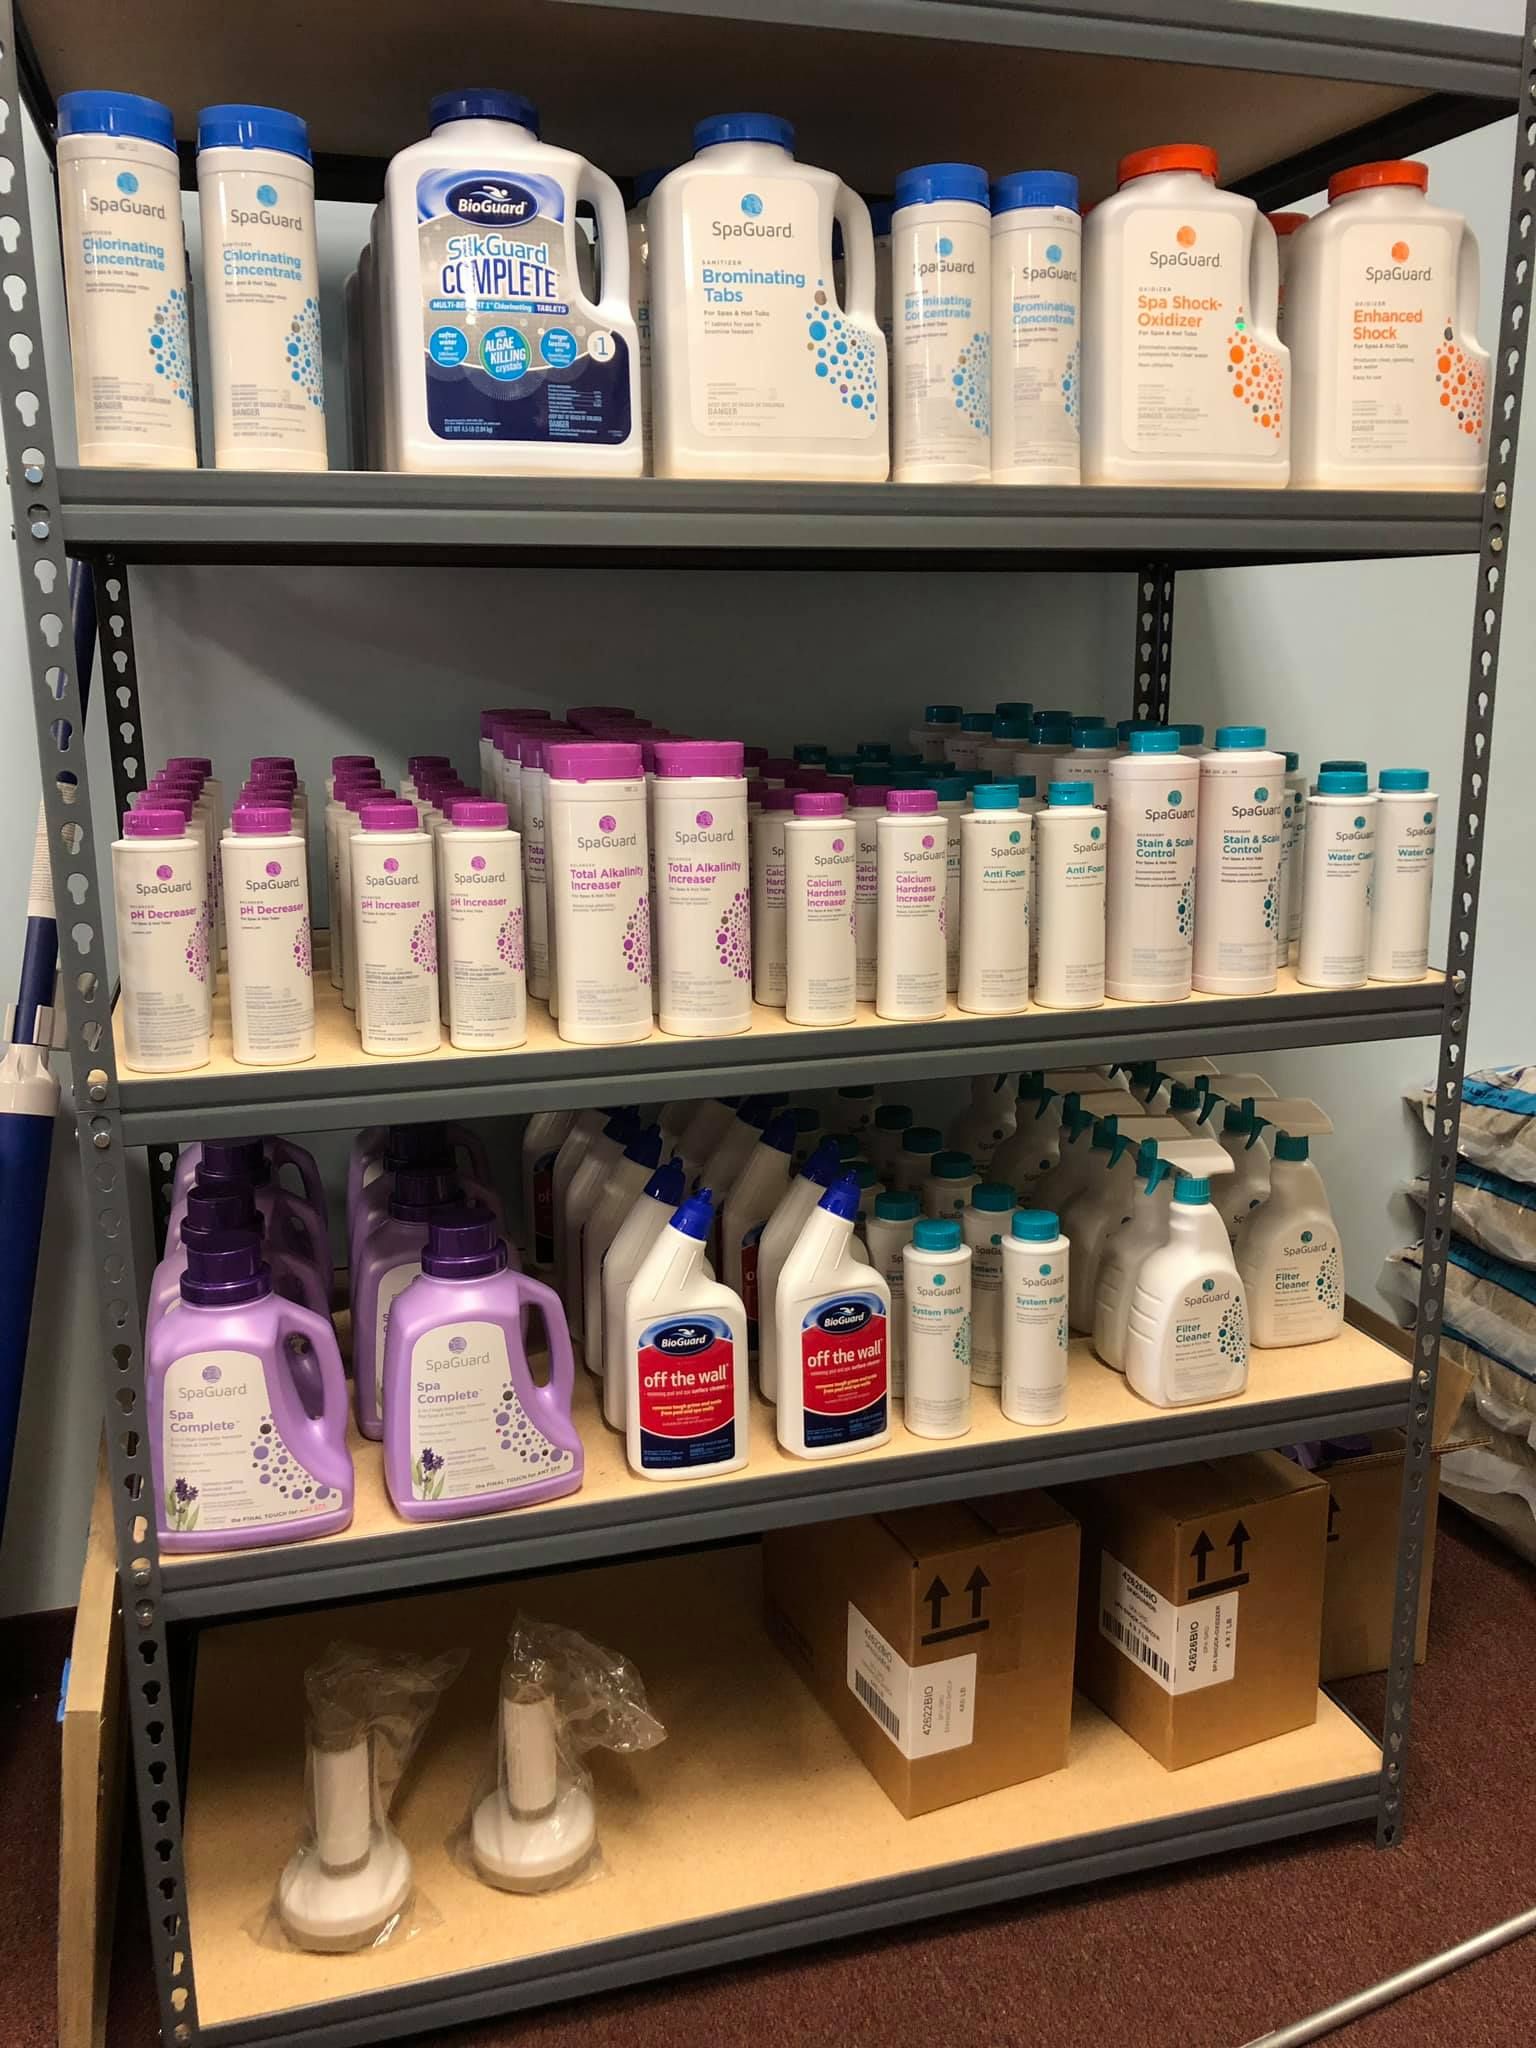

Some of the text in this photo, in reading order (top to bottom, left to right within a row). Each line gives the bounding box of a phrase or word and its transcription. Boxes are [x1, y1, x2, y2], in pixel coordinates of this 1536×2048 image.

[89, 197, 166, 220] SpaGuard
[458, 199, 526, 215] BioGuard
[231, 209, 302, 231] SpaGuard
[712, 221, 792, 240] SpaGuard
[83, 237, 164, 259] Chlorinating
[447, 234, 547, 265] SilkGuard
[83, 253, 165, 272] Concentrate
[223, 249, 301, 269] Chlorinating
[1149, 251, 1220, 269] SpaGuard
[224, 264, 302, 281] Concentrate
[702, 268, 806, 289] Brominating
[1365, 266, 1432, 284] SpaGuard
[703, 287, 744, 302] Tabs
[536, 304, 567, 314] TABLETS
[1138, 294, 1222, 312] Spa Shock-
[1137, 312, 1203, 328] Oxidizer
[1353, 307, 1423, 323] Enhanced
[1353, 325, 1397, 340] Shock
[485, 337, 515, 352] ALGAE
[597, 336, 608, 356] 1
[490, 348, 526, 365] KILLING
[495, 362, 523, 374] crystals
[577, 835, 637, 851] SpaGuard
[675, 830, 734, 845] SpaGuard
[1136, 838, 1164, 848] Stain
[1166, 839, 1172, 848] &
[1223, 835, 1250, 845] Stain
[1252, 835, 1259, 844] &
[1136, 848, 1176, 858] Control
[1222, 845, 1262, 854] Control
[1328, 852, 1355, 861] Water
[1398, 848, 1424, 857] Water
[570, 866, 643, 879] Total Alkalinity
[667, 861, 742, 873] Total Alkalinity
[983, 869, 1003, 878] Anti
[1066, 866, 1085, 875] Anti
[246, 877, 300, 893] SpaGuard
[366, 874, 419, 887] SpaGuard
[454, 872, 505, 885] SpaGuard
[571, 880, 622, 891] Increaser
[668, 874, 717, 884] Increaser
[807, 879, 842, 888] Calcium
[895, 875, 931, 884] Calcium
[136, 880, 192, 896] SpaGuard
[807, 888, 847, 898] Hardness
[896, 884, 936, 894] Hardness
[361, 900, 420, 910] pH Increaser
[463, 898, 507, 907] Increaser
[807, 898, 846, 907] Increaser
[896, 894, 936, 904] Increaser
[130, 907, 197, 920] pH Decreaser
[240, 903, 304, 916] pH Decreaser
[1283, 1242, 1327, 1256] SpaGuard
[1022, 1274, 1064, 1288] SpaGuard
[1275, 1273, 1300, 1282] Filter
[917, 1285, 961, 1297] SpaGuard
[1275, 1280, 1310, 1290] Cleaner
[1016, 1296, 1047, 1306] System
[1184, 1290, 1230, 1307] SpaGuard
[912, 1305, 941, 1317] System
[824, 1312, 864, 1328] BioGuard
[1175, 1323, 1201, 1333] Filter
[661, 1334, 706, 1348] BioGuard
[1175, 1331, 1211, 1343] Cleaner
[807, 1339, 881, 1368] off the wall
[426, 1353, 490, 1372] SpaGuard
[643, 1364, 727, 1388] off the wall
[178, 1384, 248, 1401] SpaGuard
[417, 1381, 441, 1393] Spa
[417, 1390, 479, 1404] Complete
[169, 1409, 194, 1421] Spa
[169, 1420, 236, 1434] Complete
[1188, 1620, 1200, 1673] 42626BIO
